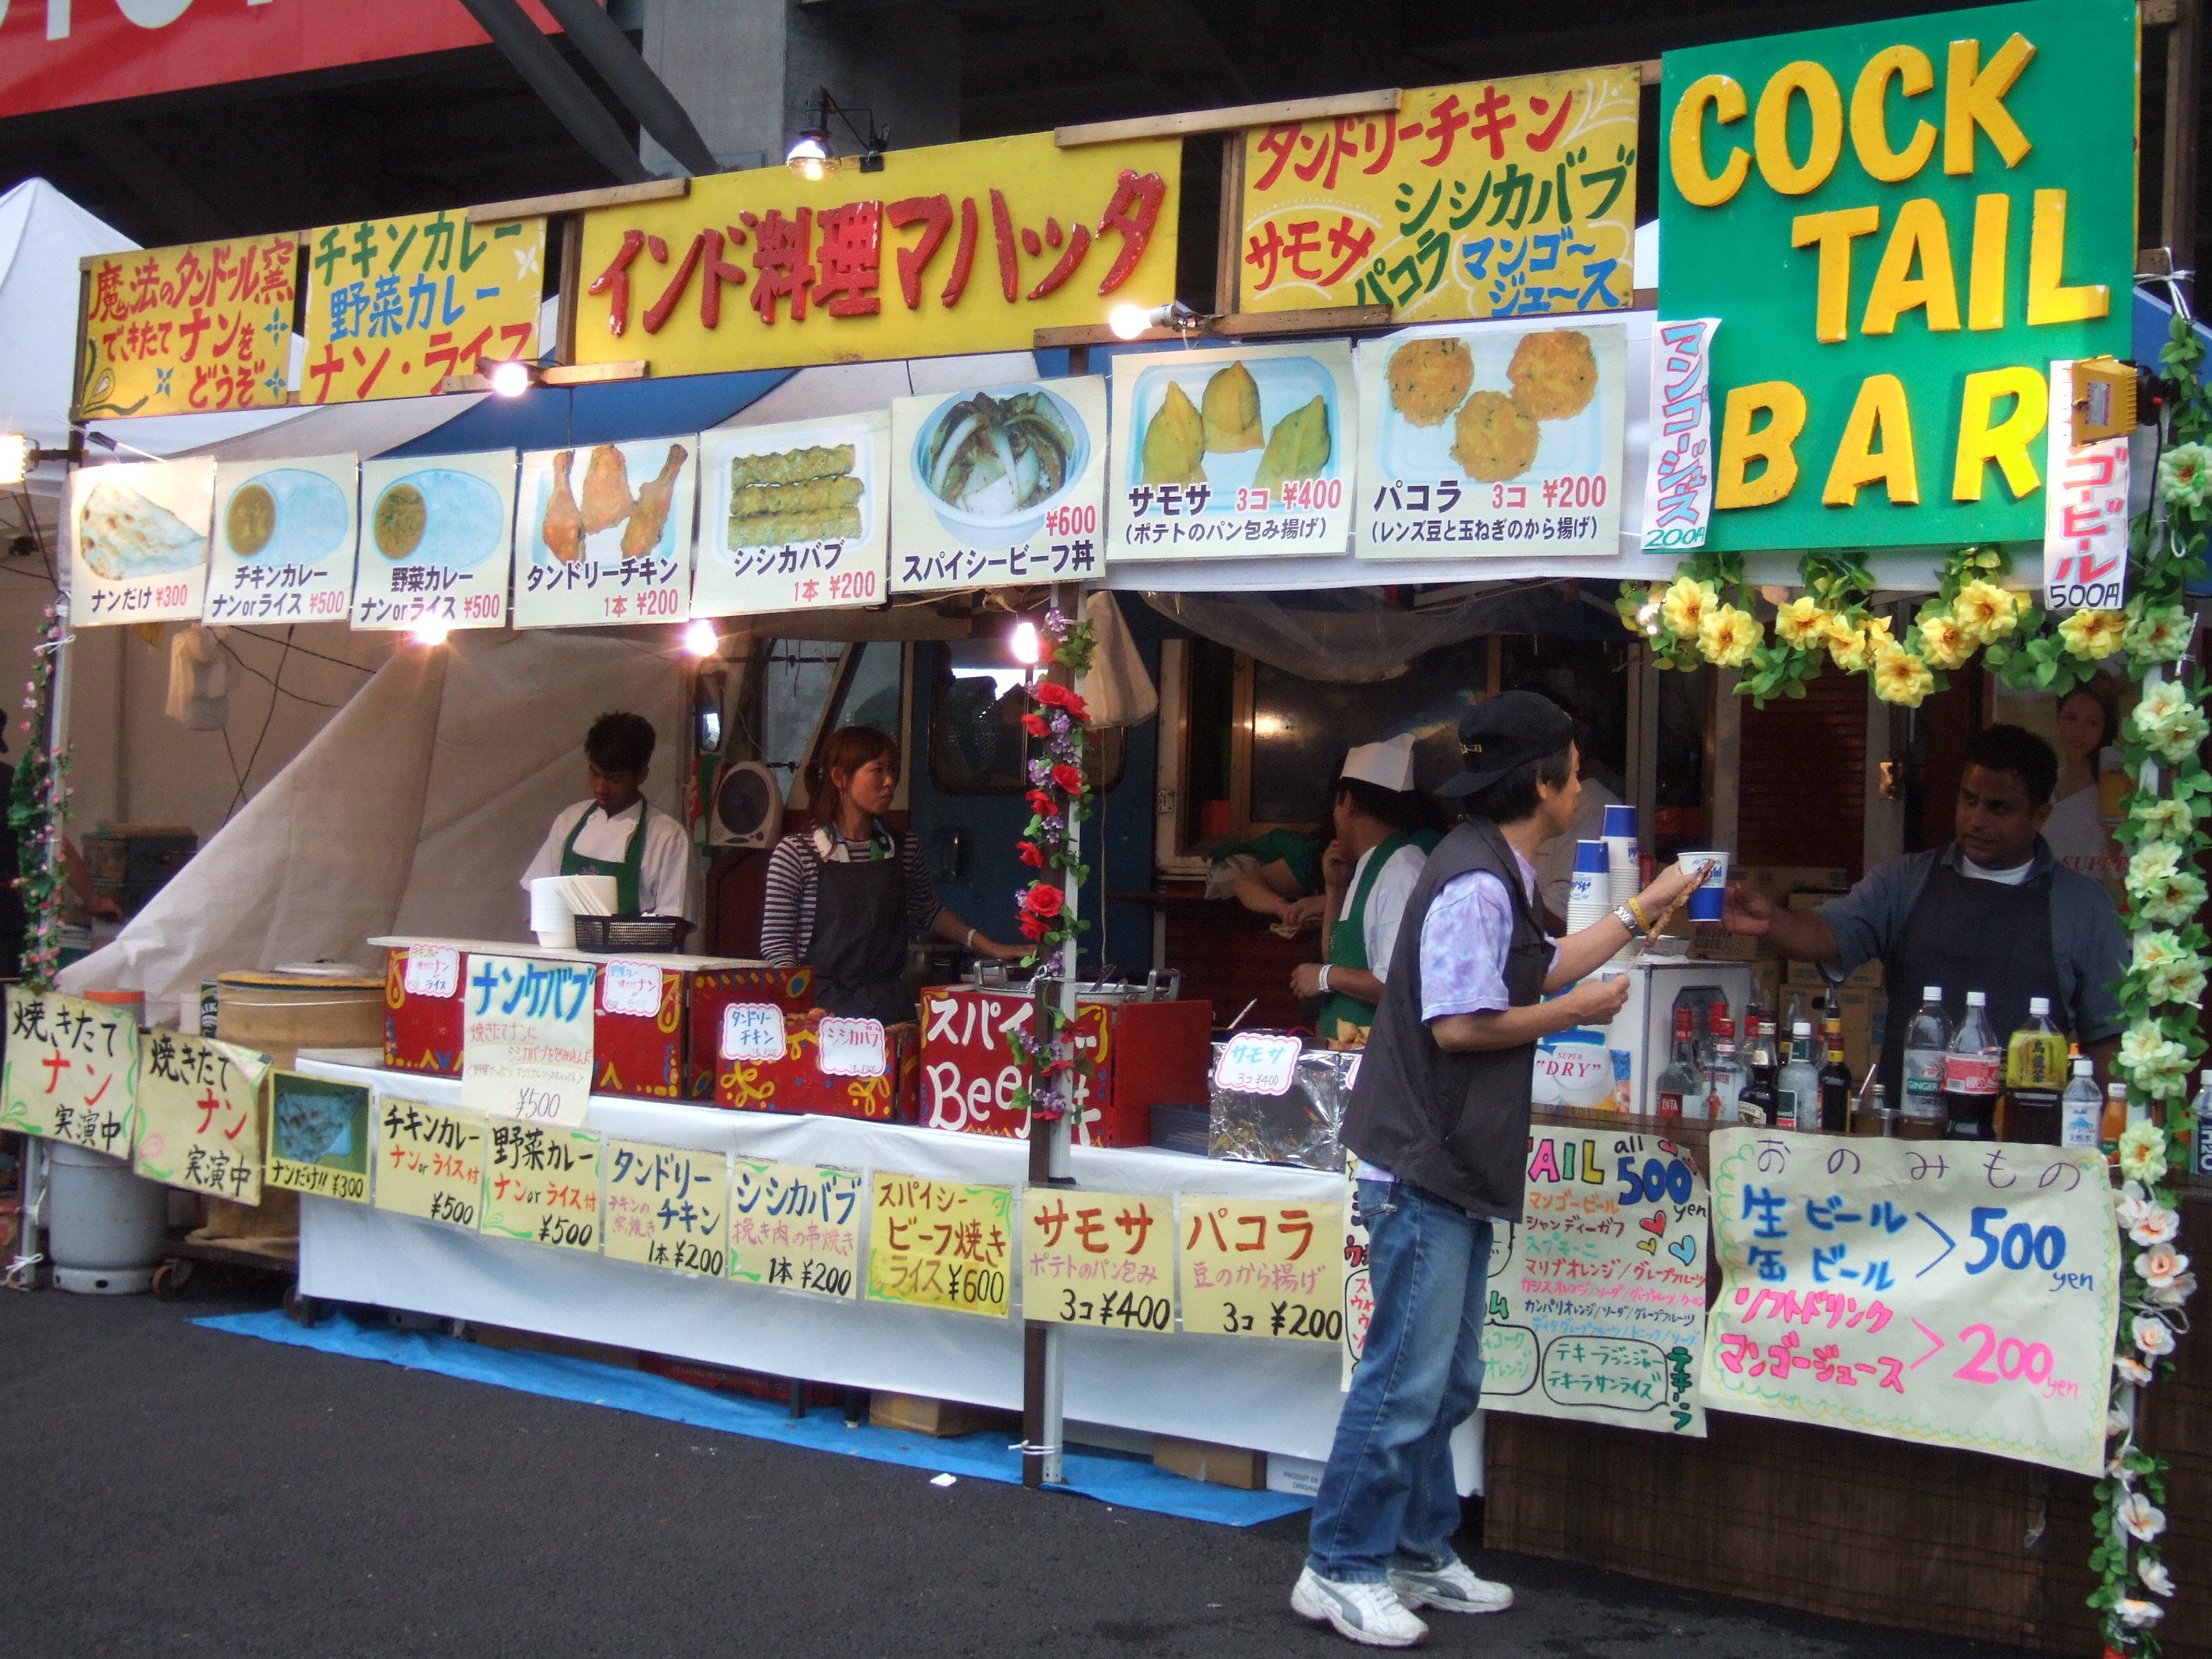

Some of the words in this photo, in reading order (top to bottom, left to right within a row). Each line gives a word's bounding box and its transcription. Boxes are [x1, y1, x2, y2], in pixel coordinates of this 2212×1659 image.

[1254, 85, 1574, 191] タンドリーチキン
[1670, 33, 2036, 207] COCK
[1396, 144, 1636, 237] シシカバブ
[315, 210, 522, 287] チキンカレー
[1245, 216, 1376, 291] サモサ
[1355, 229, 1450, 307] パコラ
[1791, 188, 2109, 343] TAIL
[89, 238, 295, 322] 魔法のタンドール窯
[1490, 259, 1619, 315] ジュース
[330, 273, 499, 342] 野菜カレー
[103, 308, 254, 363] できたてナンを
[190, 358, 266, 411] どうぞ
[1715, 366, 2048, 509] BAR
[1128, 485, 1210, 517] サモサ
[1236, 488, 1268, 513] 3コ
[1282, 479, 1342, 511] ¥400
[1373, 480, 1462, 513] パコラ
[1493, 482, 1526, 510] 3コ
[1542, 476, 1607, 509] ¥200
[2054, 419, 2128, 583] ゴービール
[1045, 506, 1096, 537] ¥600
[235, 564, 327, 588] チキンカレー
[391, 566, 473, 593] 野菜カレー
[527, 557, 678, 591] タンドリーチキン
[733, 539, 845, 577] シシカバブ
[902, 541, 1096, 583] スパイシービーフ丼
[91, 588, 152, 613] ナンだけ
[155, 584, 186, 608] ¥300
[212, 596, 301, 617] ナンorライス
[309, 591, 344, 614] ¥500
[464, 594, 500, 620] ¥500
[604, 595, 628, 618] 1本
[637, 589, 678, 616] ¥200
[794, 579, 819, 603] 1本
[829, 570, 875, 600] ¥200
[472, 961, 596, 1022] ナンケバブ
[13, 1001, 117, 1057] 焼きたて
[732, 1010, 771, 1027] タンドリー
[740, 1029, 774, 1045] チキン
[828, 1026, 882, 1047] シシカバブ
[42, 1049, 112, 1105] ナン
[149, 1034, 231, 1092] 焼きたて
[1231, 1045, 1285, 1065] サモサ
[516, 1087, 561, 1118] ¥500
[1256, 1074, 1279, 1087] ¥400
[54, 1104, 121, 1151] 実演中
[197, 1088, 247, 1140] ナン
[384, 1105, 480, 1150] チキンカレー
[185, 1144, 252, 1197] 実演中
[492, 1125, 594, 1171] 野菜カレー
[1528, 1137, 1605, 1184] AIL
[1615, 1136, 1643, 1154] all
[1757, 1139, 2080, 1191] おのみもの
[332, 1174, 363, 1199] ¥300
[612, 1148, 711, 1199] タンドリー
[879, 1181, 968, 1212] スパイシー
[1617, 1156, 1692, 1206] 500
[431, 1192, 474, 1225] ¥500
[658, 1198, 721, 1235] チキン
[737, 1173, 861, 1225] シシカバブ
[1529, 1189, 1619, 1215] マンゴービール
[1674, 1205, 1706, 1223] yen
[539, 1214, 593, 1247] ¥500
[889, 1216, 1006, 1268] ビーフ焼き
[1034, 1198, 1153, 1254] サモサ
[1187, 1208, 1313, 1261] パコラ
[1526, 1215, 1625, 1237] シャンディーガフ
[1965, 1206, 2066, 1275] 500
[649, 1240, 669, 1264] 1本
[675, 1240, 723, 1276] ¥200
[769, 1257, 793, 1284] 1本
[802, 1258, 852, 1296] ¥200
[890, 1256, 944, 1294] ライス
[948, 1264, 1004, 1304] ¥600
[2050, 1272, 2095, 1292] yen
[1060, 1289, 1094, 1321] 3コ
[1101, 1290, 1170, 1330] ¥400
[1223, 1303, 1254, 1333] 3コ
[1271, 1301, 1342, 1341] ¥200
[1734, 1287, 1893, 1333] ソフトドリンク
[1720, 1330, 1904, 1393] マンゴージュース
[1953, 1323, 2054, 1384] 200
[1548, 1370, 1661, 1401] テキーラサンライズ
[1666, 1346, 1692, 1431] テキーラ
[2045, 1376, 2080, 1398] yen
